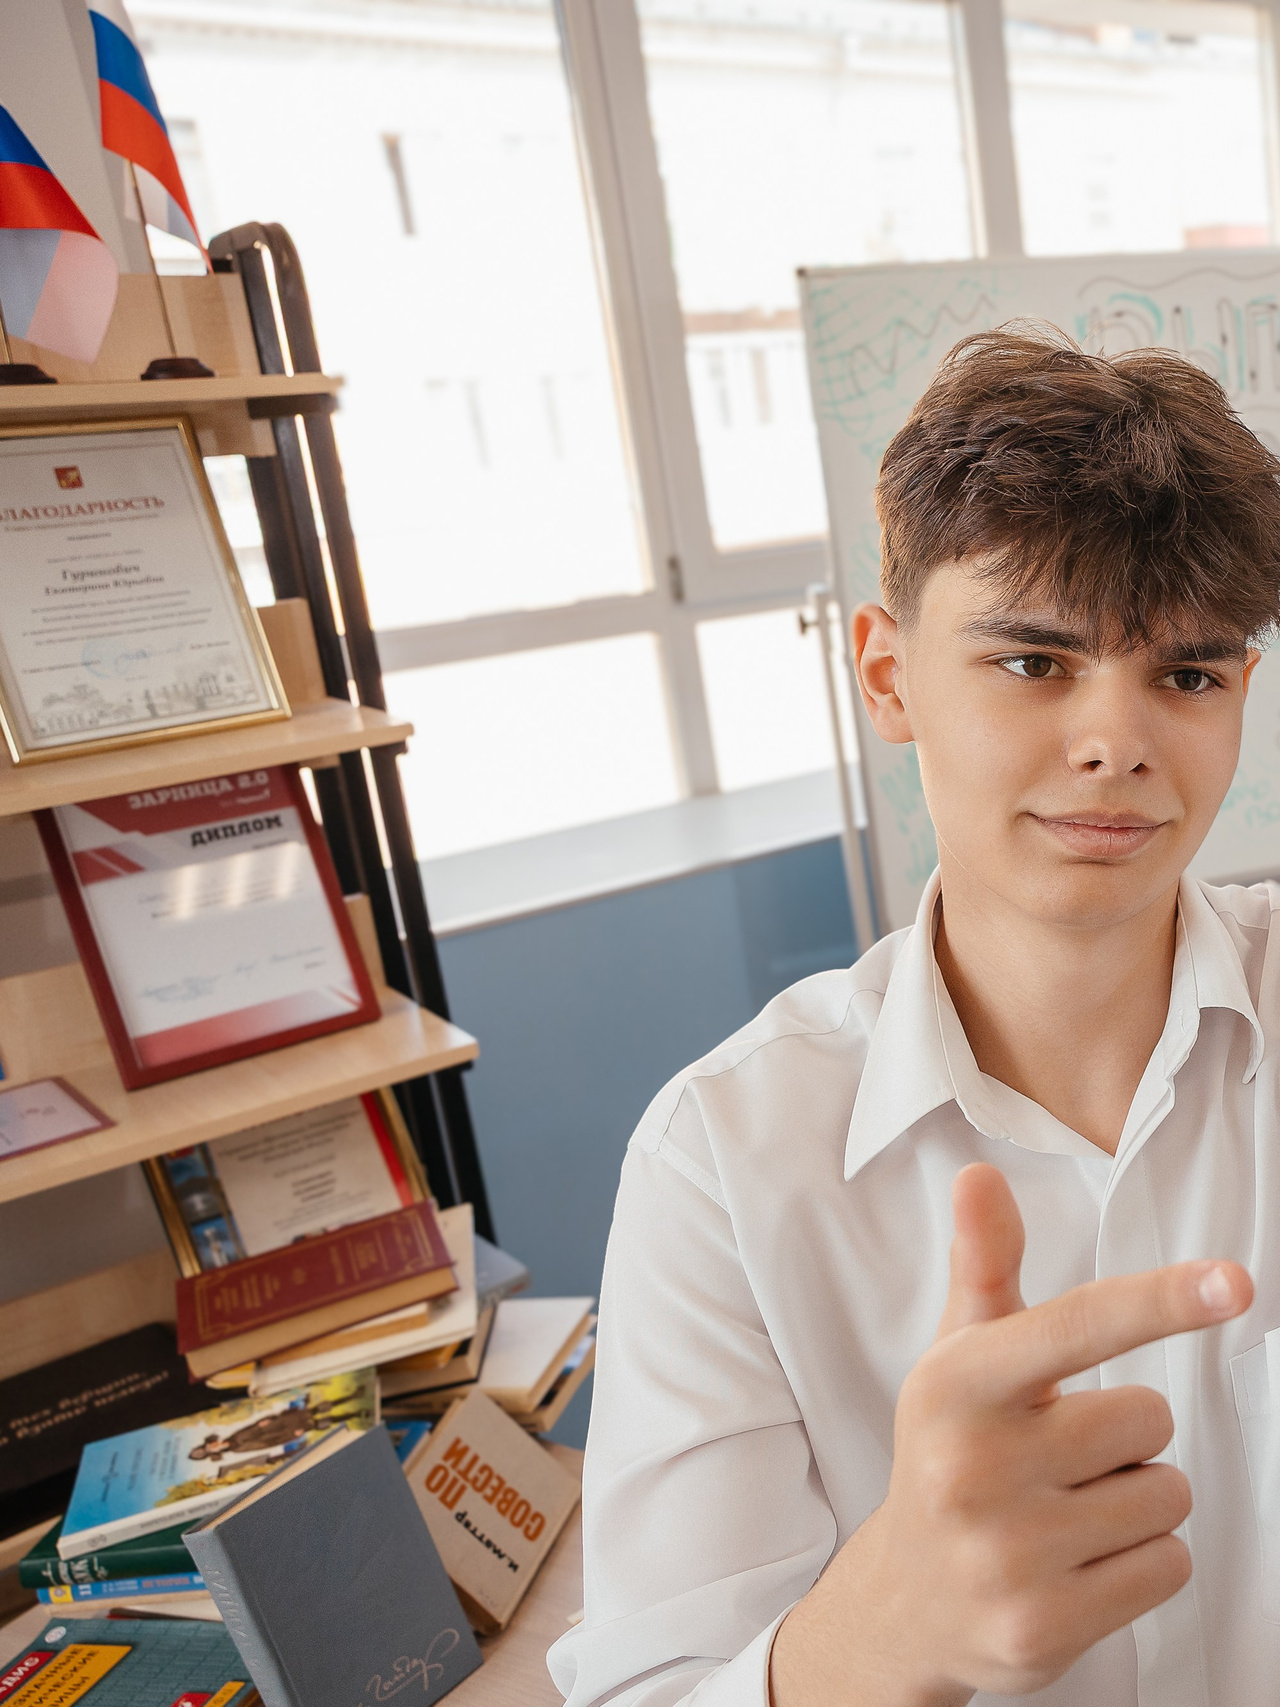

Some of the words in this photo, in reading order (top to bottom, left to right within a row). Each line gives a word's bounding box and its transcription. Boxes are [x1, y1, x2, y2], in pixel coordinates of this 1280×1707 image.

[0, 497, 165, 521] ЛАГОДАРНОСТЬ
[128, 778, 234, 810] ЗАРНИЦА
[236, 769, 270, 790] 2.0
[190, 814, 284, 848] ДИПЛОМ
[424, 1462, 468, 1512] ПО
[441, 1437, 547, 1543] СОВЕСТИ
[26, 1650, 100, 1707] ИЧЕСКИЕ
